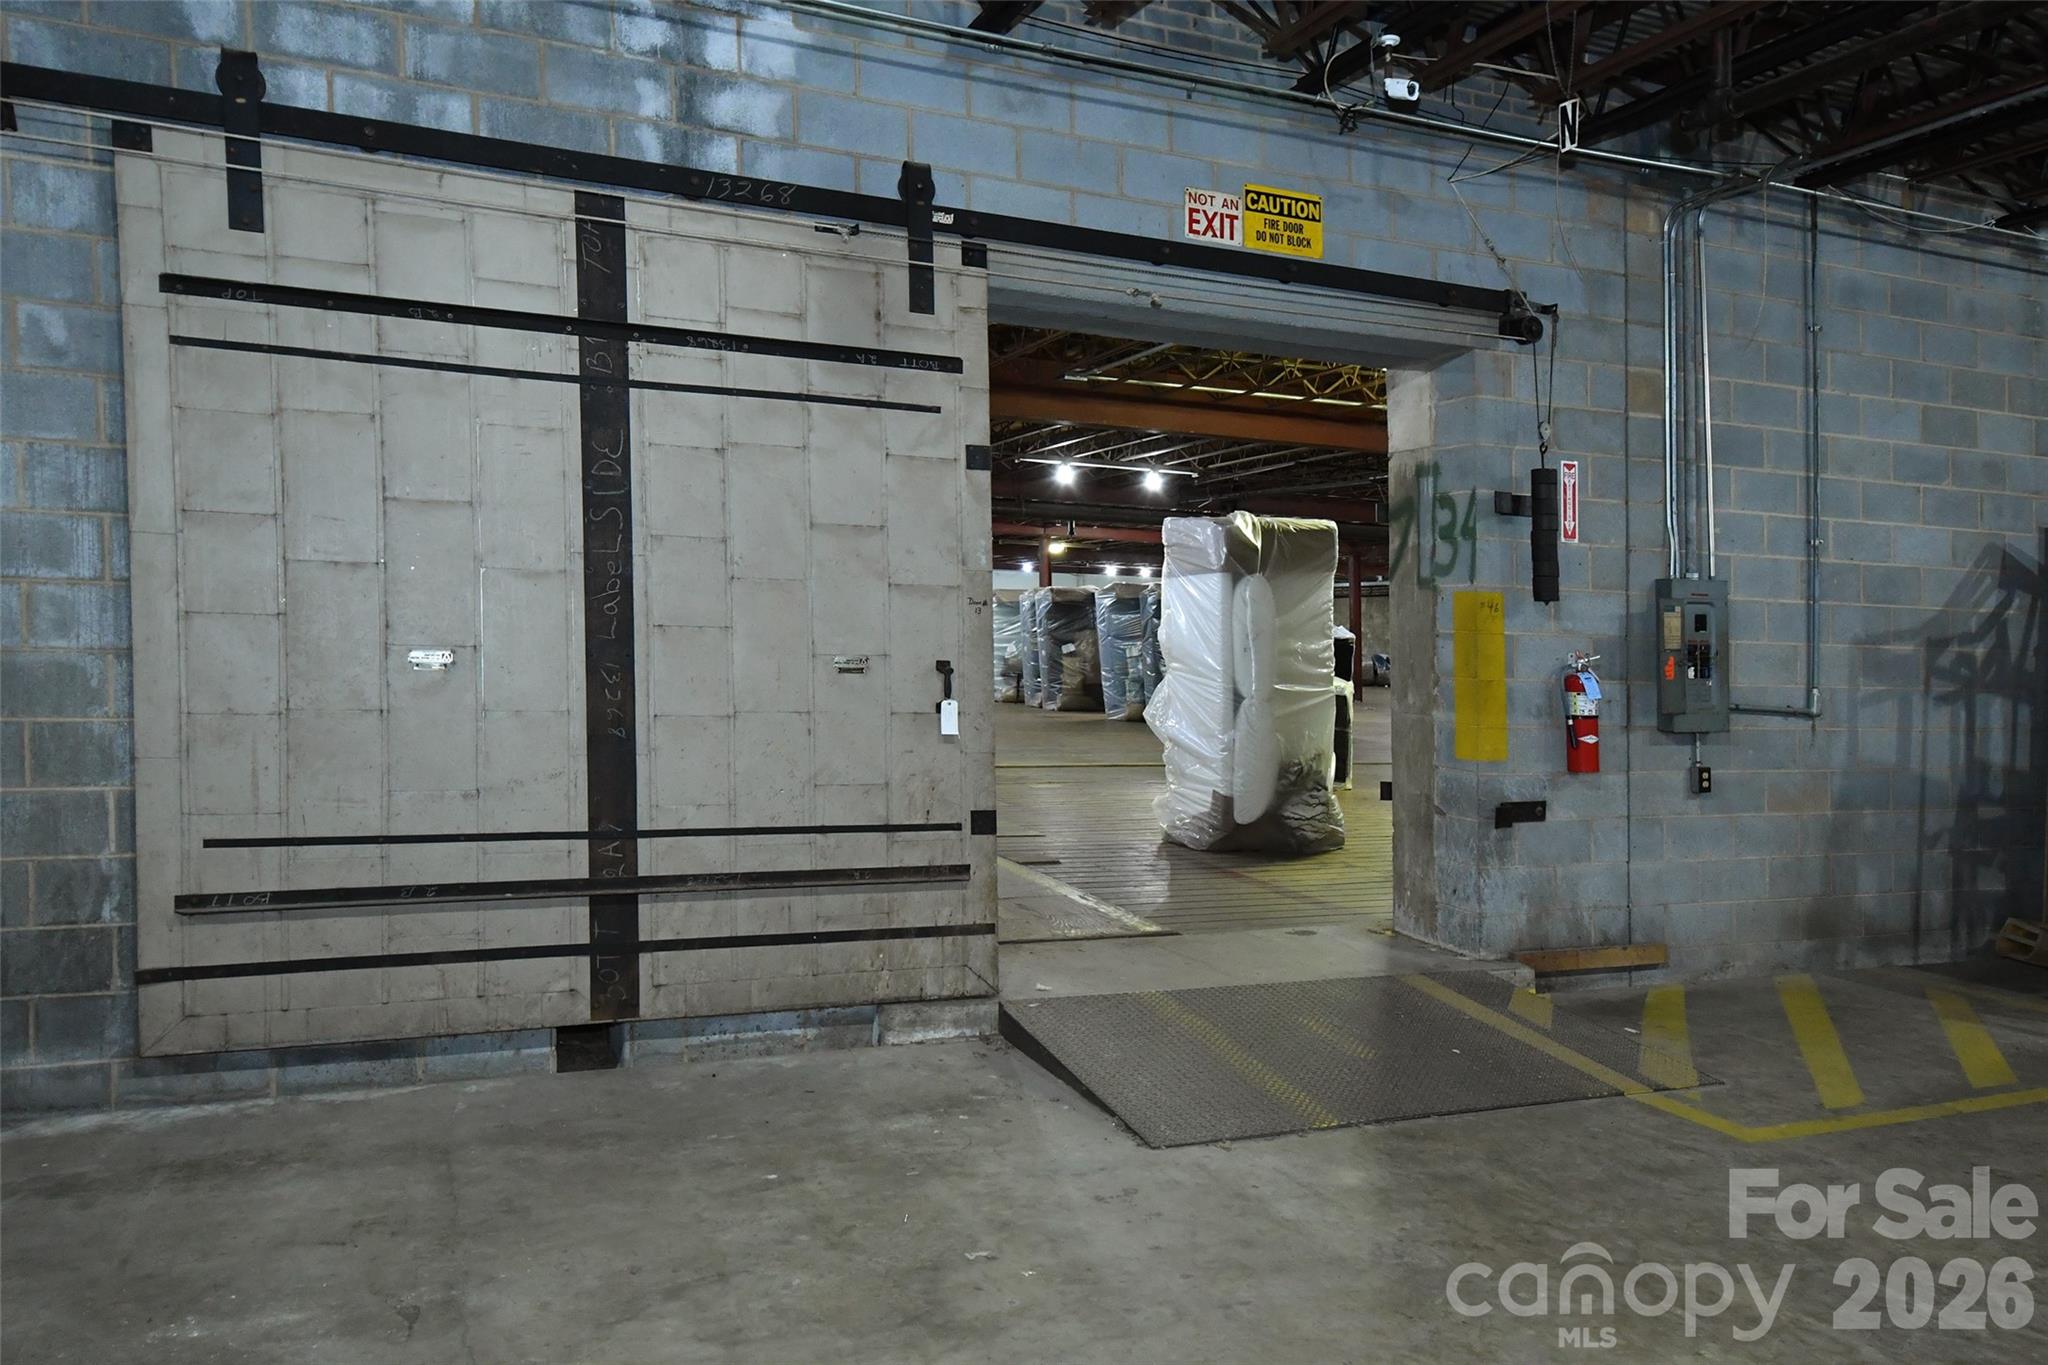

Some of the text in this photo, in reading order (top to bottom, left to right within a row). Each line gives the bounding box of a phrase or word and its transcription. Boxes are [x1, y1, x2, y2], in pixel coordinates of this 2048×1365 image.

[1560, 100, 1578, 150] N
[705, 176, 798, 205] 13268
[1188, 192, 1239, 211] NOT AN
[1246, 192, 1320, 220] CAUTION
[1188, 207, 1239, 241] EXIT
[1263, 218, 1304, 235] FIRE DOOR
[1256, 230, 1267, 242] DO
[1269, 232, 1285, 245] NOT
[1287, 235, 1312, 249] BLOCK
